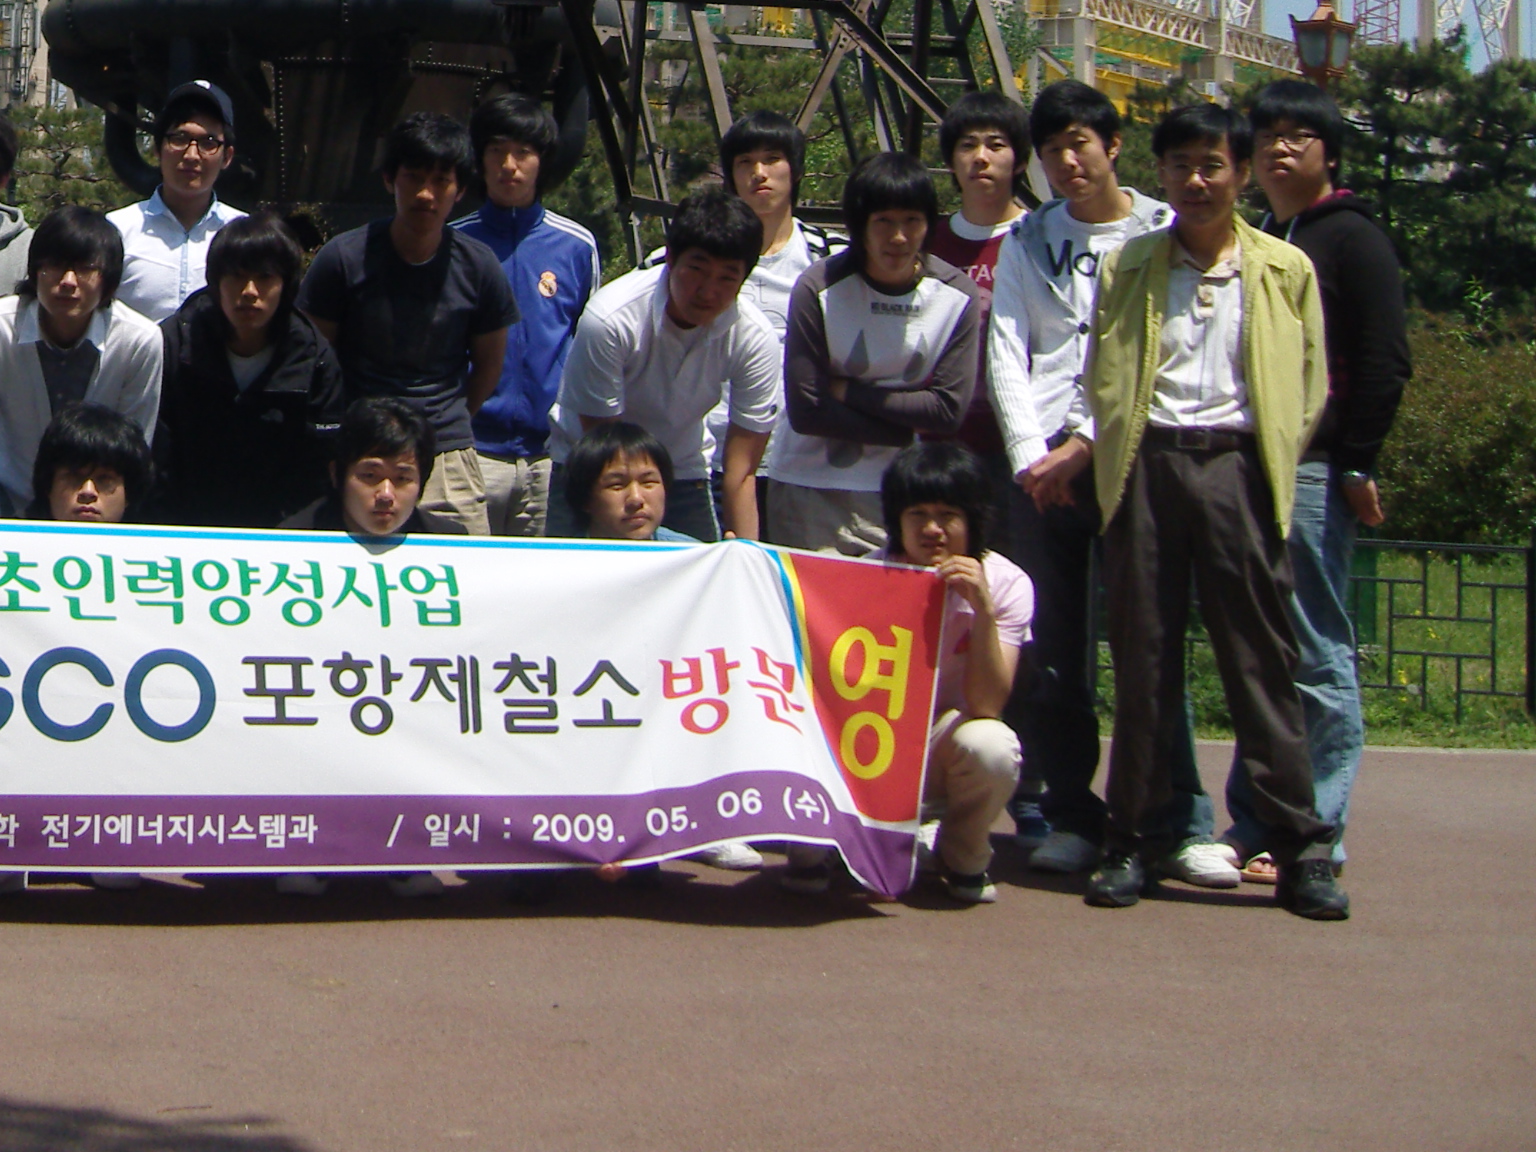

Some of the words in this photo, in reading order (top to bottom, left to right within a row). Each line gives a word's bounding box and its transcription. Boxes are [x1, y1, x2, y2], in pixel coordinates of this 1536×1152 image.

[241, 651, 643, 736] 포항제철소
[830, 624, 914, 780] 영
[41, 814, 319, 849] 전기에너지시스템과
[424, 813, 480, 847] 일시
[532, 813, 626, 844] 2009.
[645, 805, 698, 837] 05.
[716, 787, 763, 819] 06
[782, 786, 831, 825] (수)
